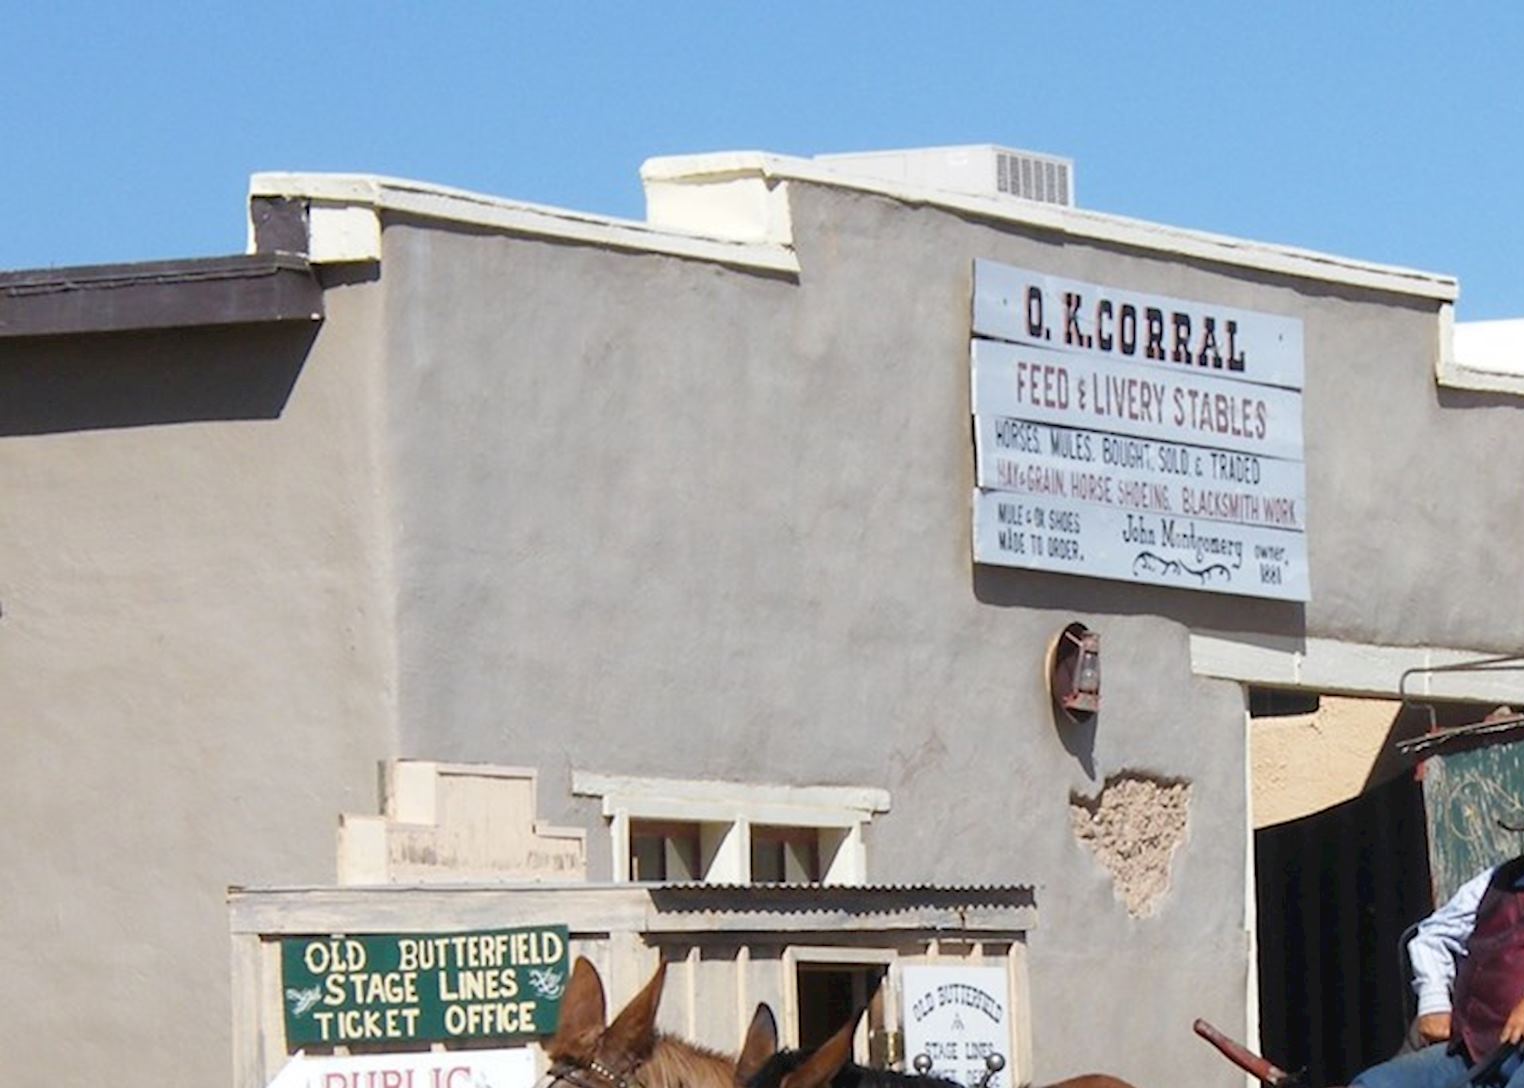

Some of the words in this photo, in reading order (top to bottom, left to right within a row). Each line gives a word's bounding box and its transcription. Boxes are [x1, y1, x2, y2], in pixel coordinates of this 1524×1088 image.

[1017, 361, 1069, 411] FEED
[1092, 372, 1165, 425] LIVERY
[1173, 387, 1268, 440] STABLES
[1210, 451, 1260, 486] TRADED
[1070, 470, 1112, 503] HORSE
[1181, 485, 1259, 523] BLACKSMITH
[1262, 496, 1298, 527] WORK
[1049, 509, 1081, 534] SHOES
[1121, 513, 1156, 544] John
[1160, 518, 1243, 570] Montgomery
[304, 942, 367, 974] OLD
[398, 931, 564, 972] BUTTERFIELD
[323, 973, 419, 1006] STAGE
[438, 968, 519, 1001] LINES
[313, 1007, 420, 1041] TICKET
[444, 1001, 537, 1036] OFFICE
